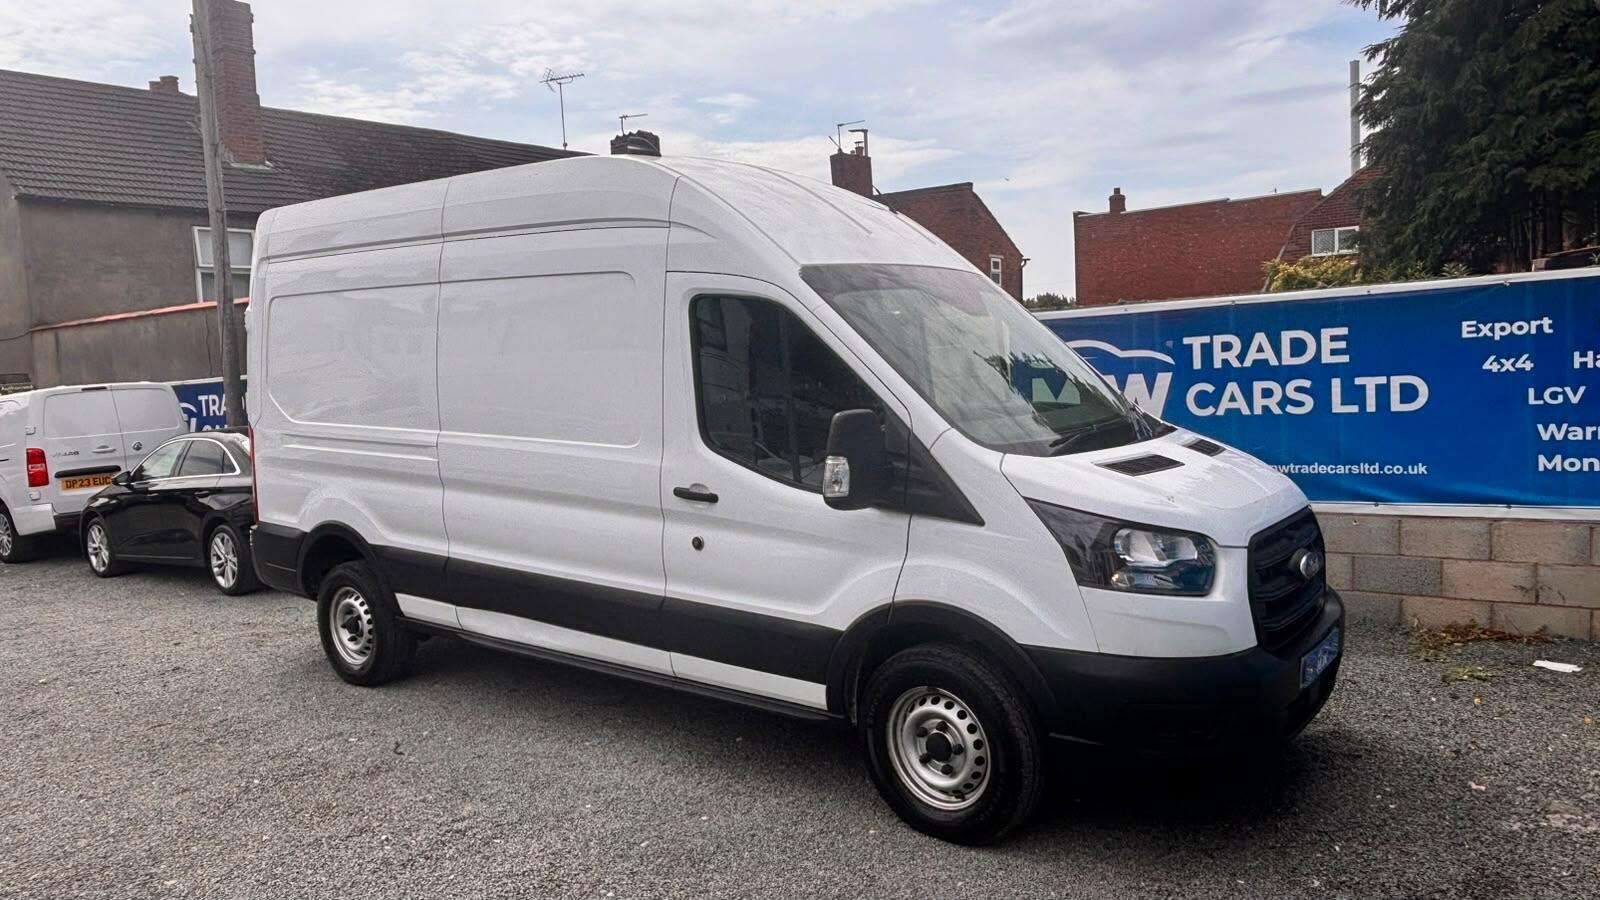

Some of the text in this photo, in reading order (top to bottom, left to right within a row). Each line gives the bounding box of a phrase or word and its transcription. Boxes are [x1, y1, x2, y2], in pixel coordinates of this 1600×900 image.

[1462, 317, 1553, 340] Export
[1183, 327, 1349, 370] TRADE
[1482, 353, 1534, 372] 4x4
[1186, 375, 1429, 417] CARS LTD
[1528, 386, 1586, 404] LGV
[1537, 423, 1600, 440] War
[1538, 454, 1600, 472] Mon
